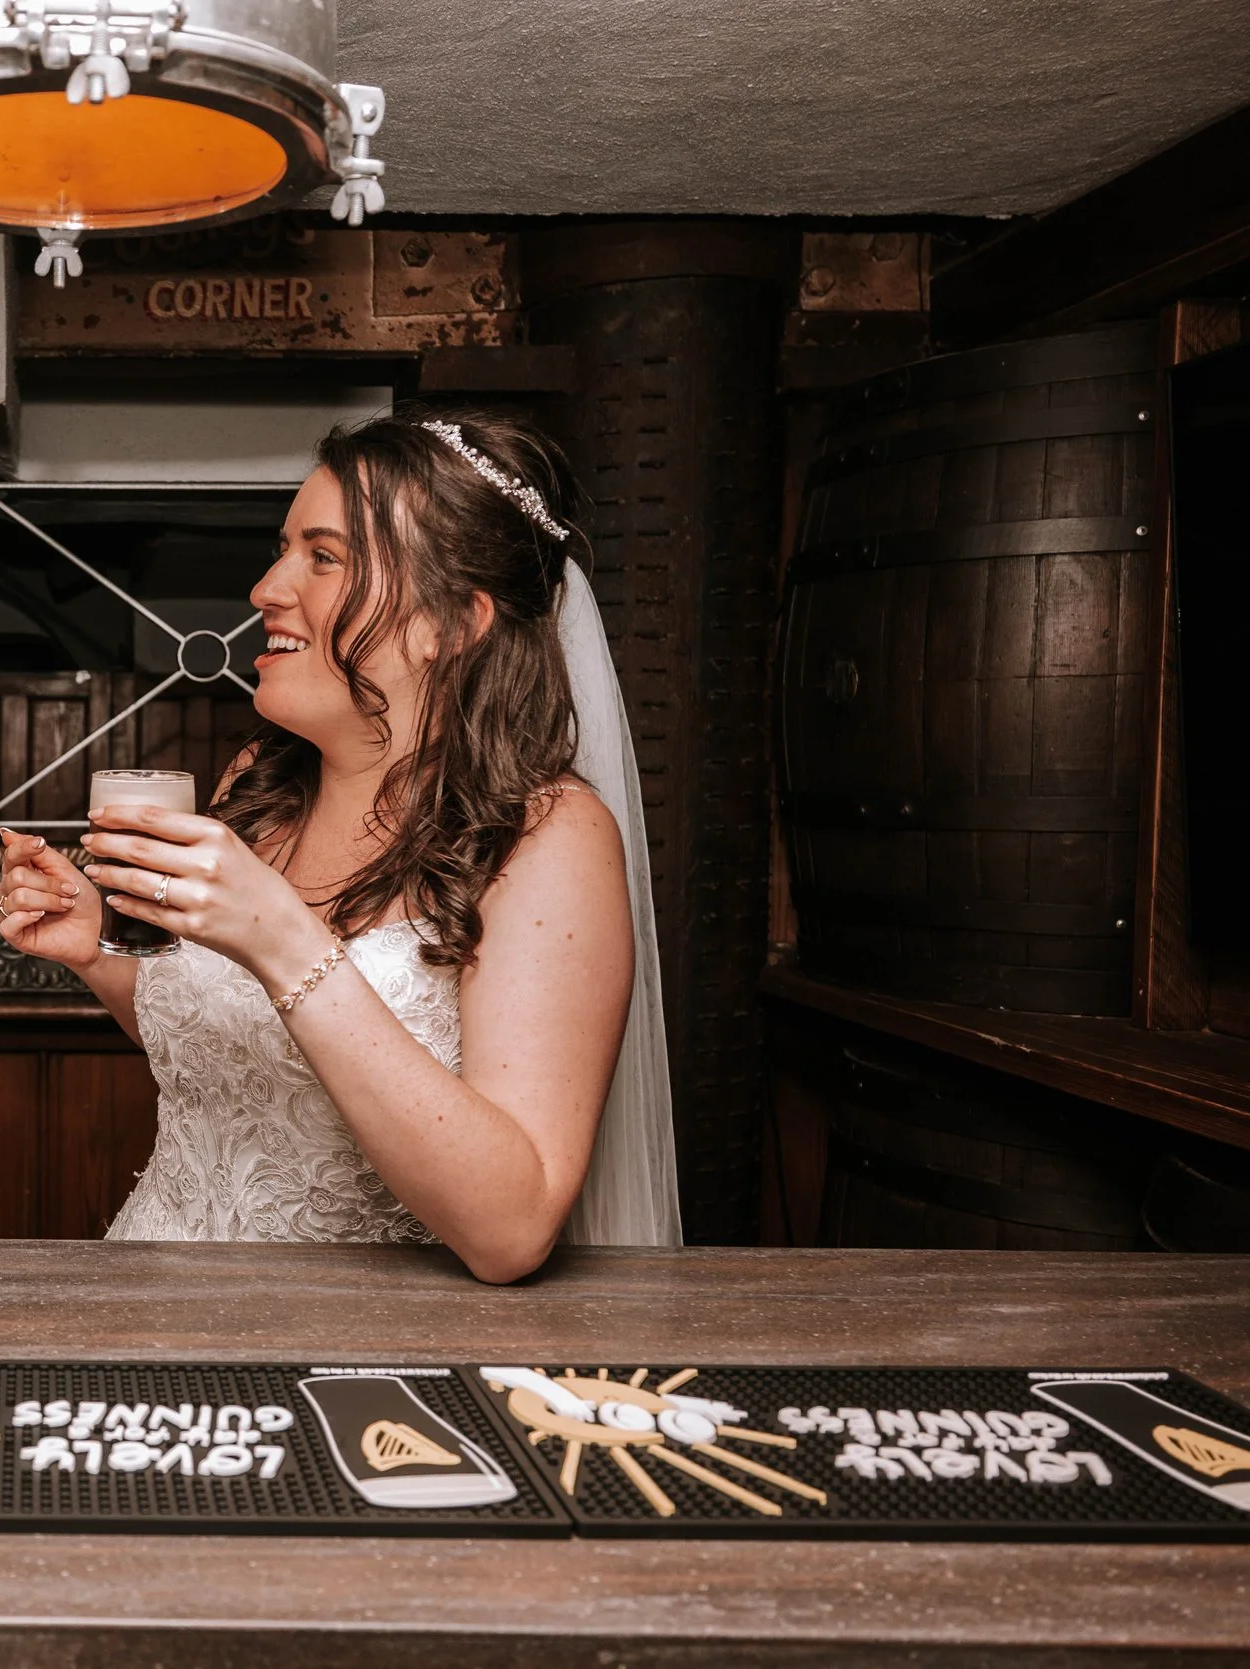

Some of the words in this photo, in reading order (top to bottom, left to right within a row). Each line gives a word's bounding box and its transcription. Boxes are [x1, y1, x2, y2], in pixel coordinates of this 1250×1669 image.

[147, 277, 313, 320] CORNER
[11, 1400, 295, 1433] GUINNESS
[777, 1406, 1070, 1438] GUINNESS
